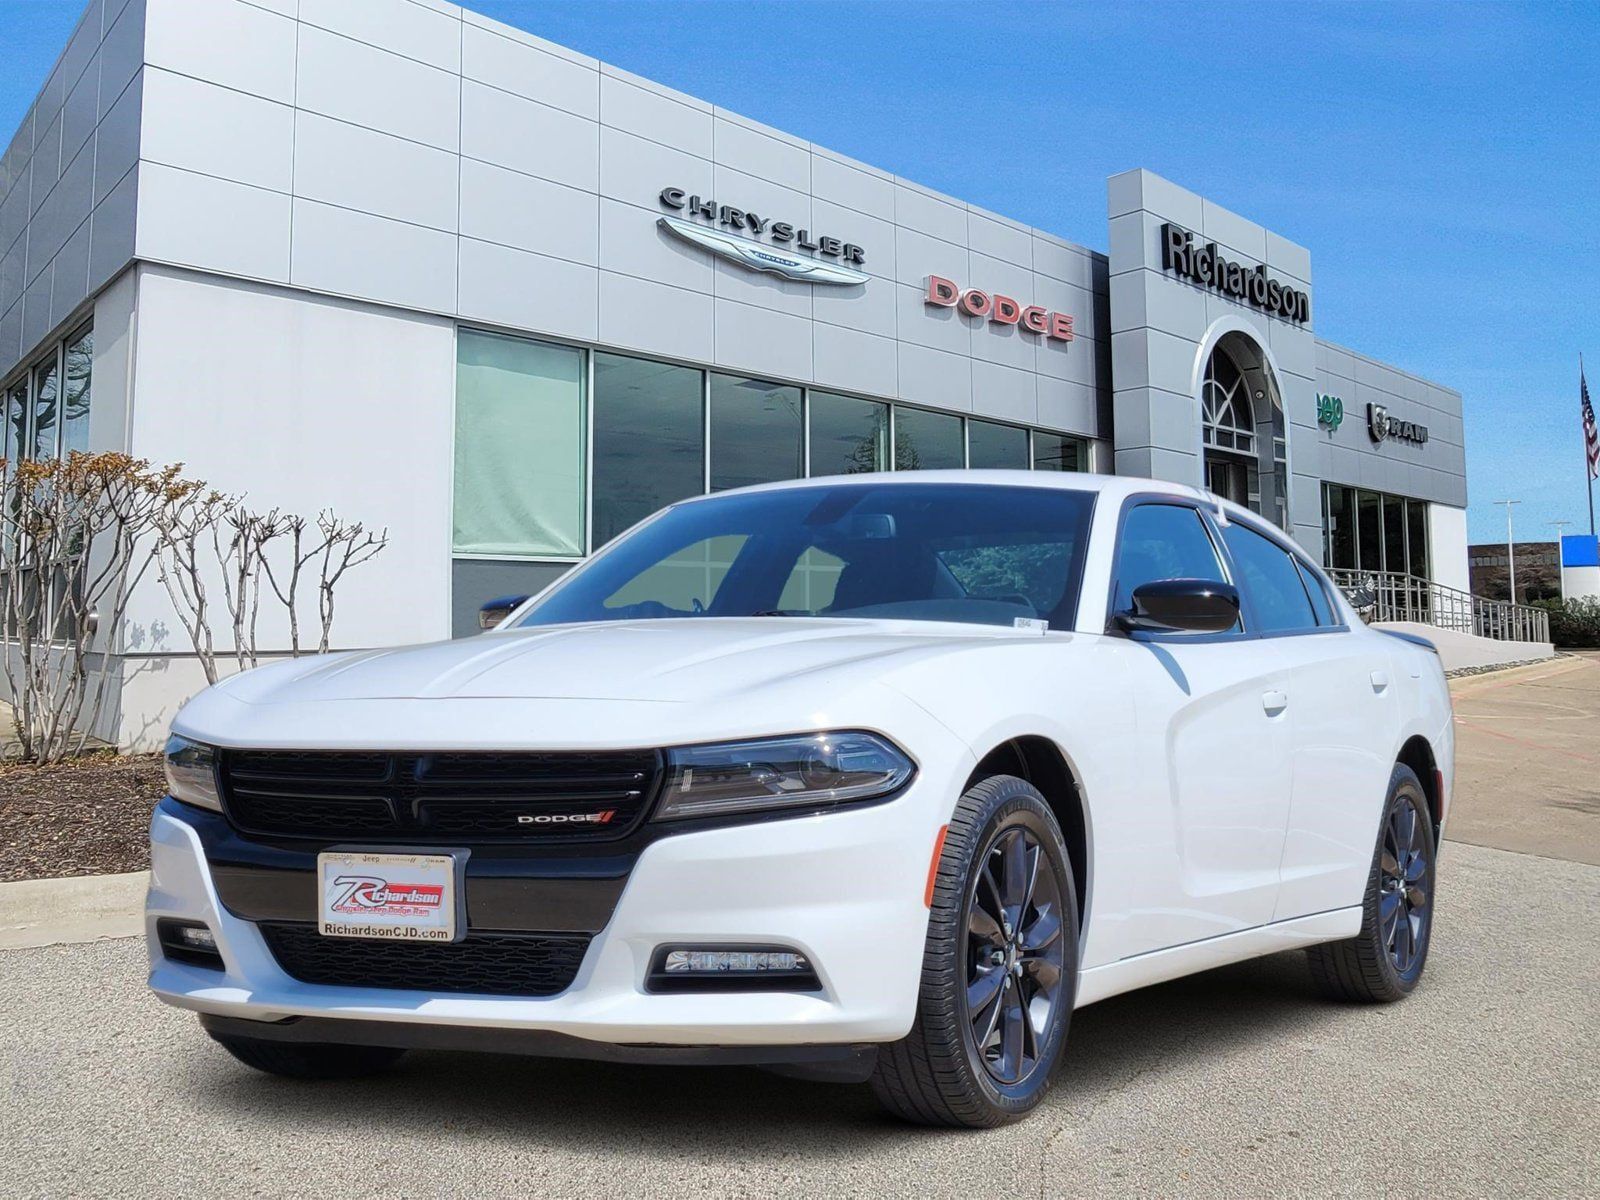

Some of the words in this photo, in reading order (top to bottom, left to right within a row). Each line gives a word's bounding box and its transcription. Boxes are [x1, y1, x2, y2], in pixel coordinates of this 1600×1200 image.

[659, 187, 866, 264] CHRYSLER
[1160, 223, 1310, 323] Richardson
[923, 274, 1074, 343] DODGE
[1388, 416, 1429, 443] RAM
[517, 813, 602, 824] DODGE
[362, 854, 380, 863] Jeep
[332, 875, 439, 911] Richardson
[388, 906, 412, 917] Dodge
[414, 907, 430, 916] Ram
[324, 923, 448, 939] RichardsonCJD.com
